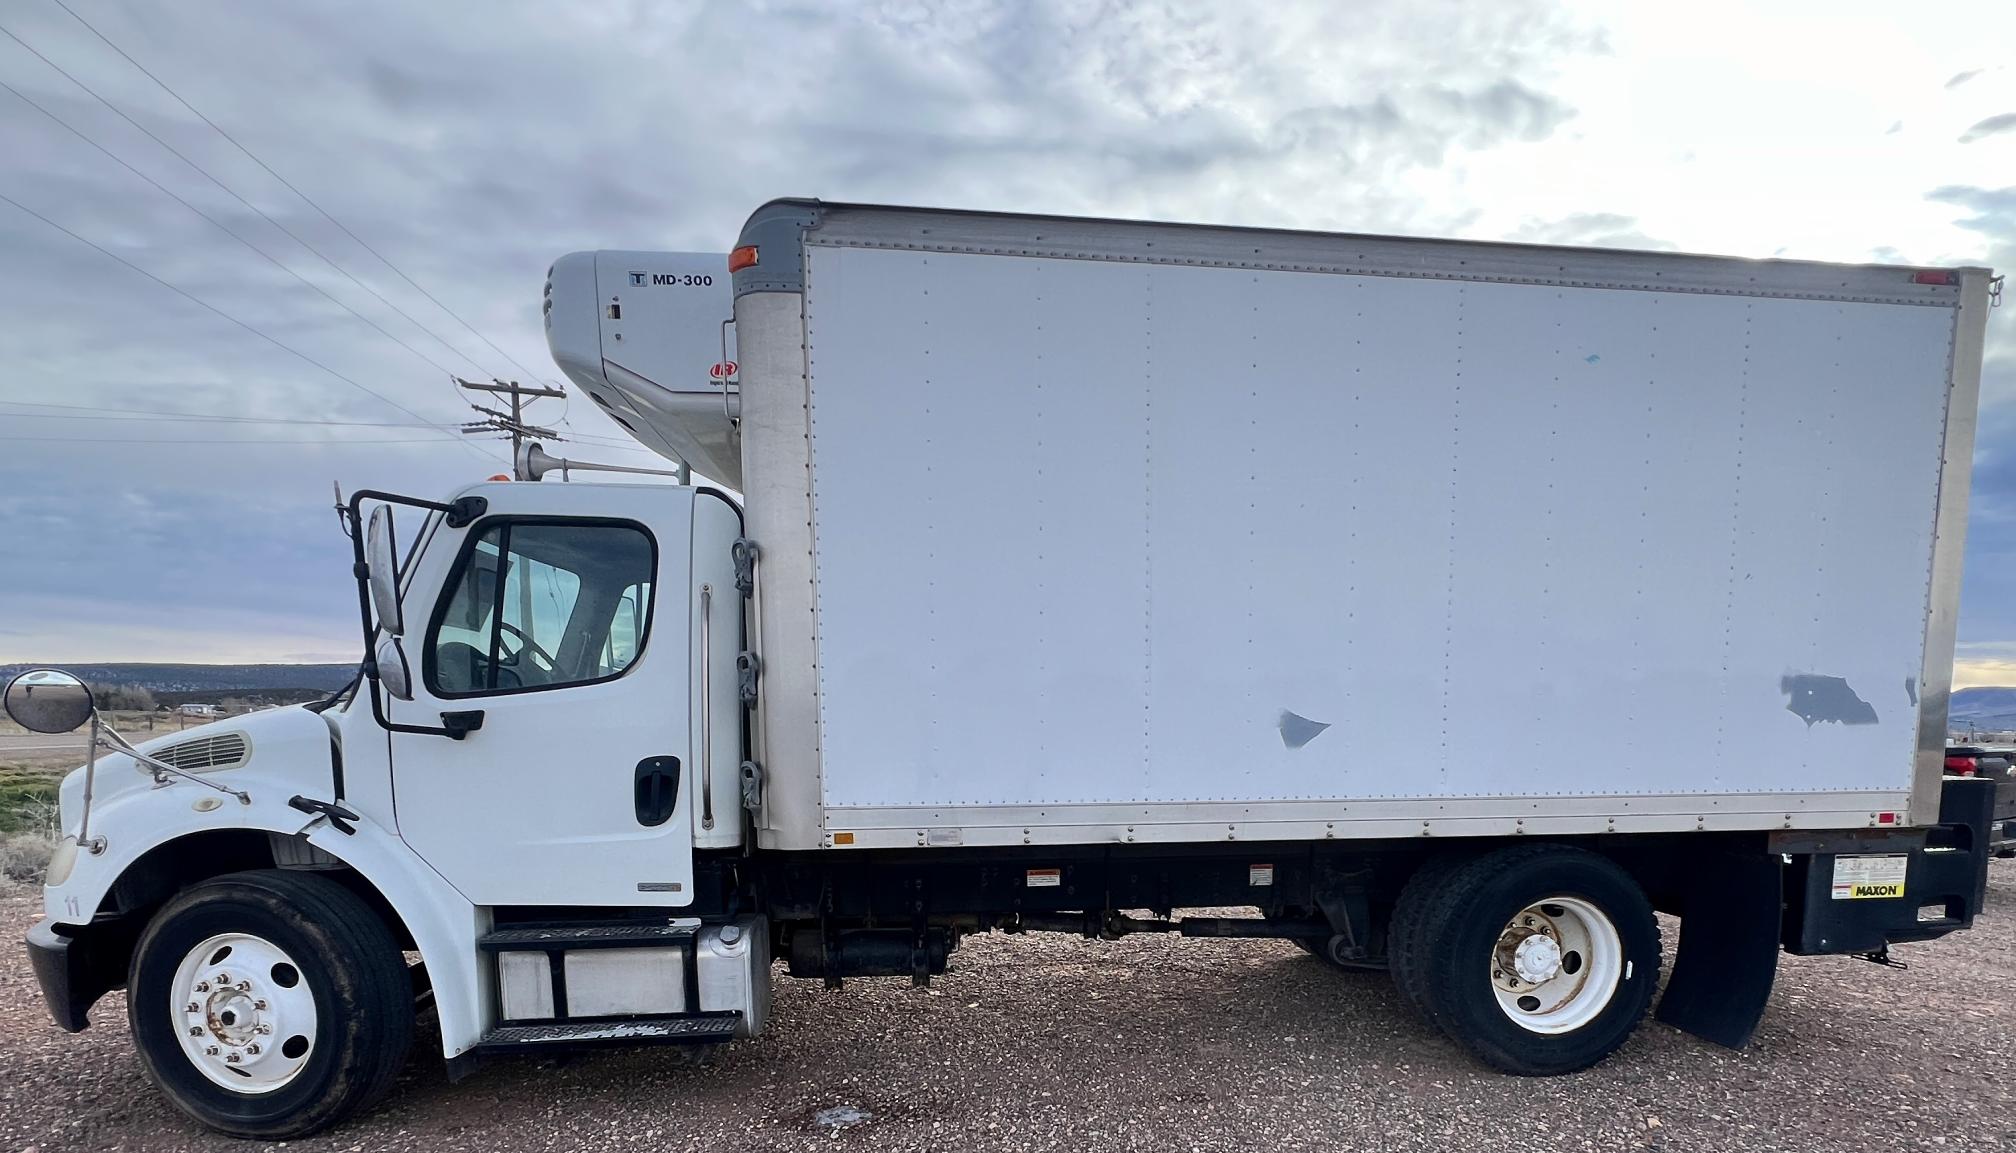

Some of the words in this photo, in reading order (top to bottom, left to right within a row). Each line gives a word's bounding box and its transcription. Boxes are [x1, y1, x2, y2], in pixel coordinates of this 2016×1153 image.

[653, 274, 712, 286] MD-300
[1856, 885, 1897, 896] MAXON
[64, 896, 80, 917] 11
